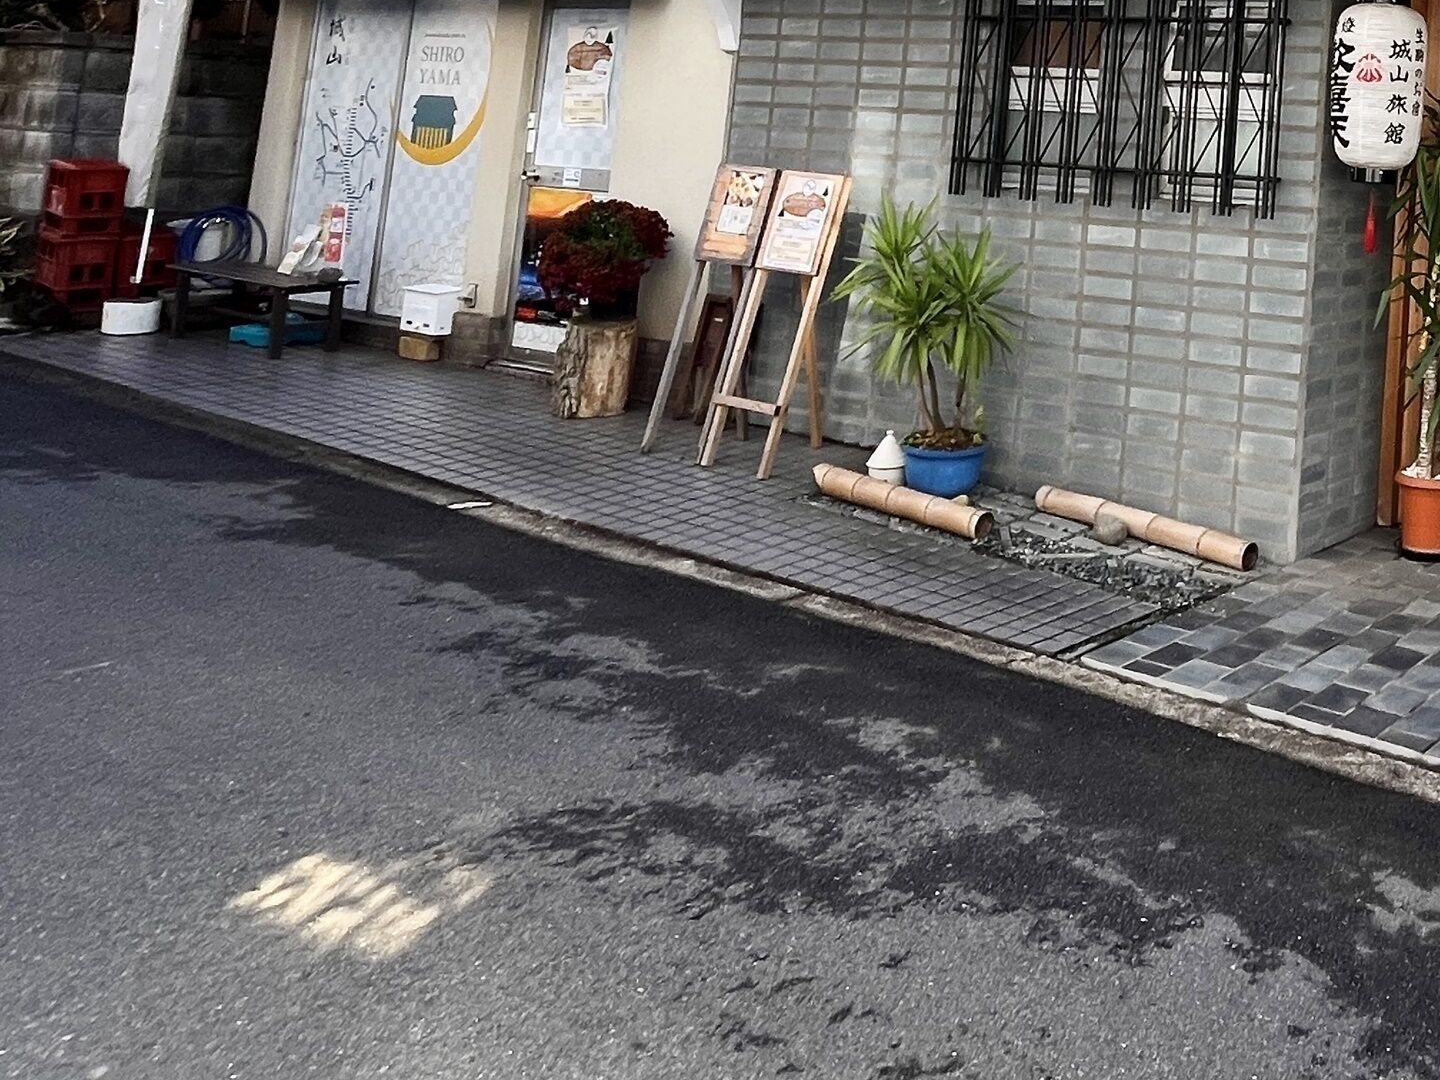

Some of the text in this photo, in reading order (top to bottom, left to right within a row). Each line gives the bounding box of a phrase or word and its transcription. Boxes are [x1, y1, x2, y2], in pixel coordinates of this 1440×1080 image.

[421, 45, 465, 62] SHIRO
[420, 68, 460, 85] YAMA
[1384, 39, 1412, 145] 城山旅館
